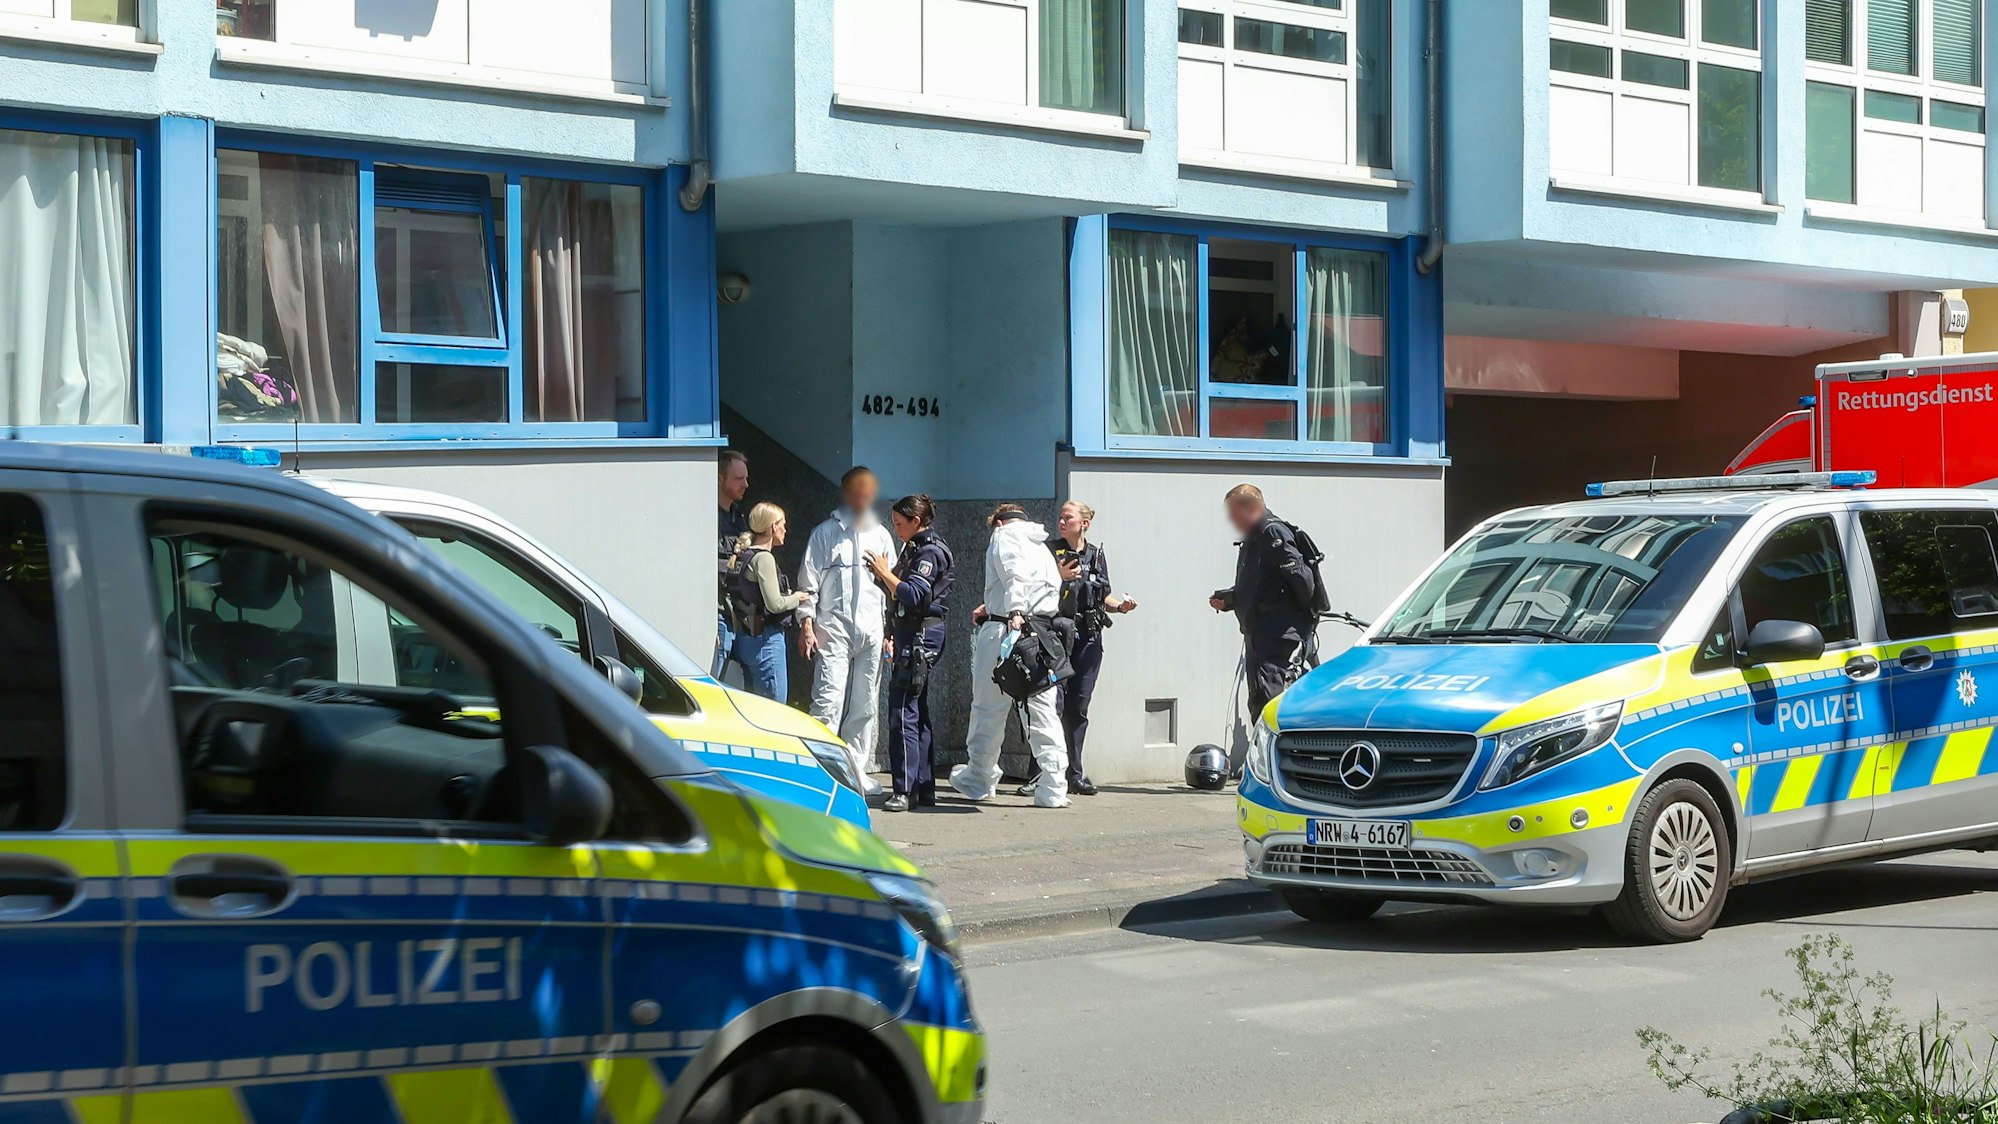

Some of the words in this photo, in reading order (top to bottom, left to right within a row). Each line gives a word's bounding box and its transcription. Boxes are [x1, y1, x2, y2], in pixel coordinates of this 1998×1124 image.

[1951, 314, 1966, 328] 480
[862, 394, 940, 417] 482-494
[1838, 383, 1993, 412] Rettungsdienst
[1330, 674, 1490, 692] POLIZEI
[1777, 691, 1864, 732] POLIZEI
[245, 936, 522, 1013] POLIZEI
